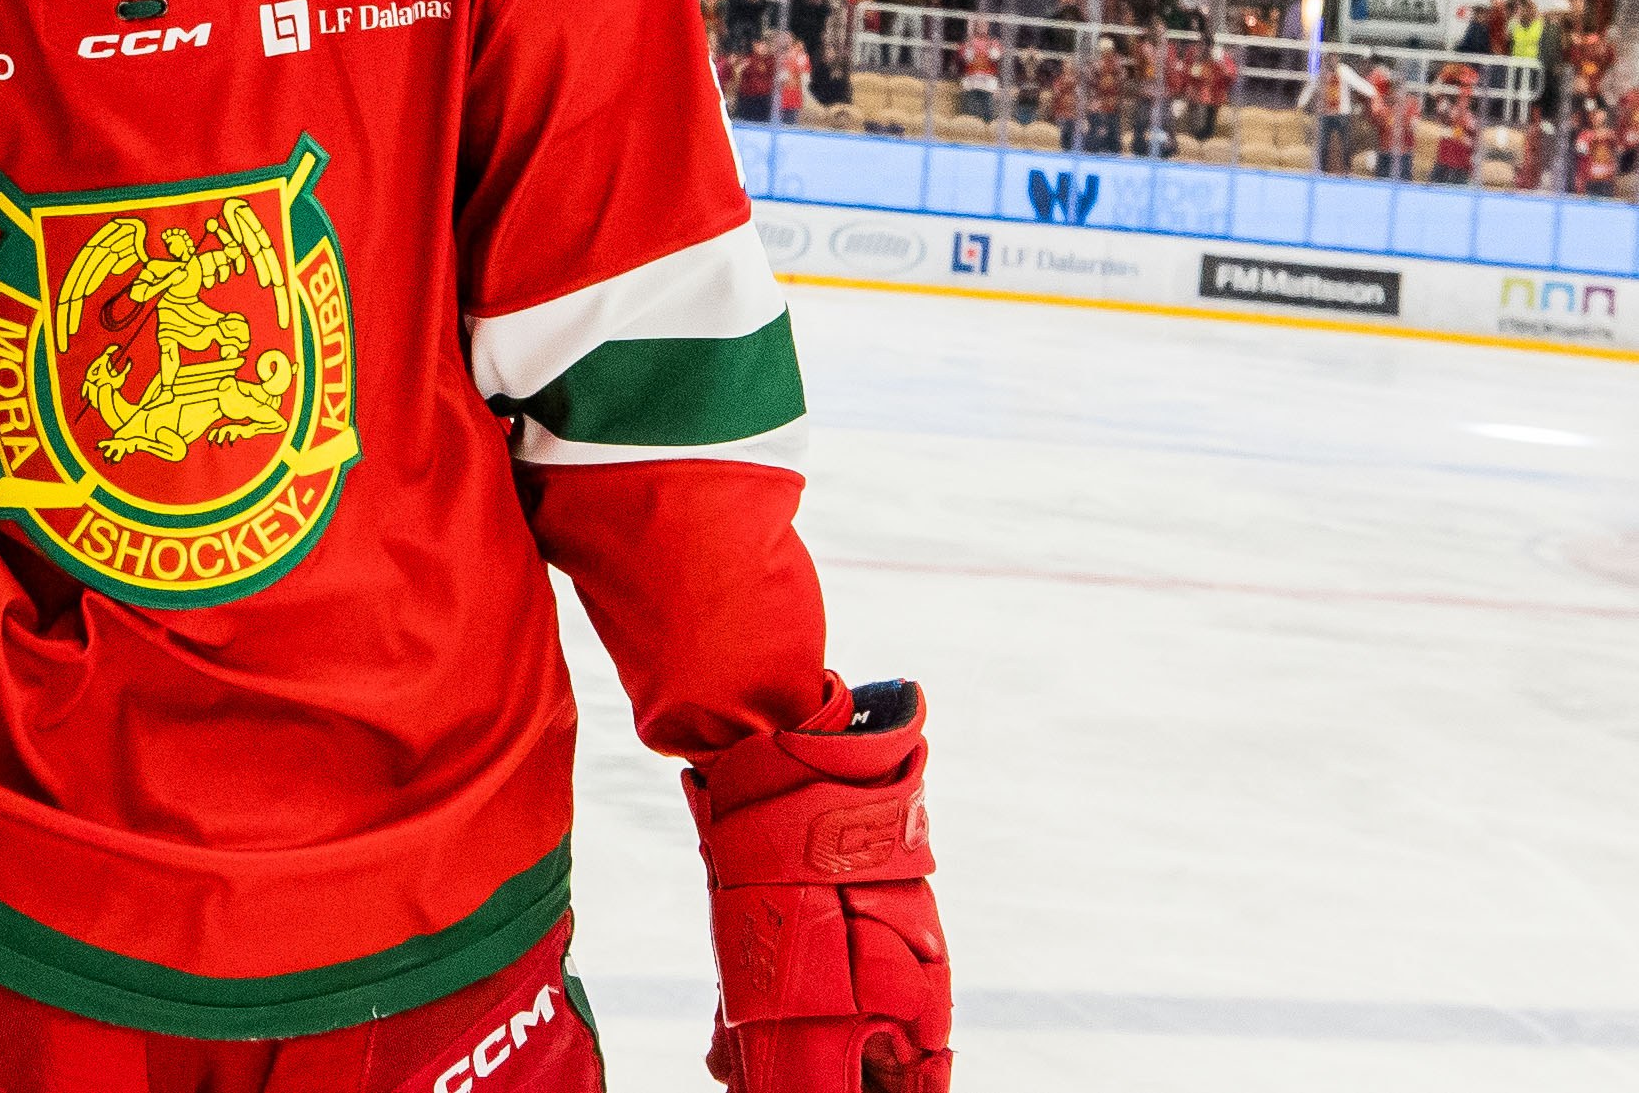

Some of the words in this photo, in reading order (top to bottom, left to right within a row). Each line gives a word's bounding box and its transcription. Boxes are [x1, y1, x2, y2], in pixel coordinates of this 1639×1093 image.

[319, 7, 352, 34] LF
[77, 22, 212, 59] CCM
[1215, 262, 1260, 292] FM
[310, 261, 348, 431] KLUBB
[433, 983, 560, 1093] CCM
